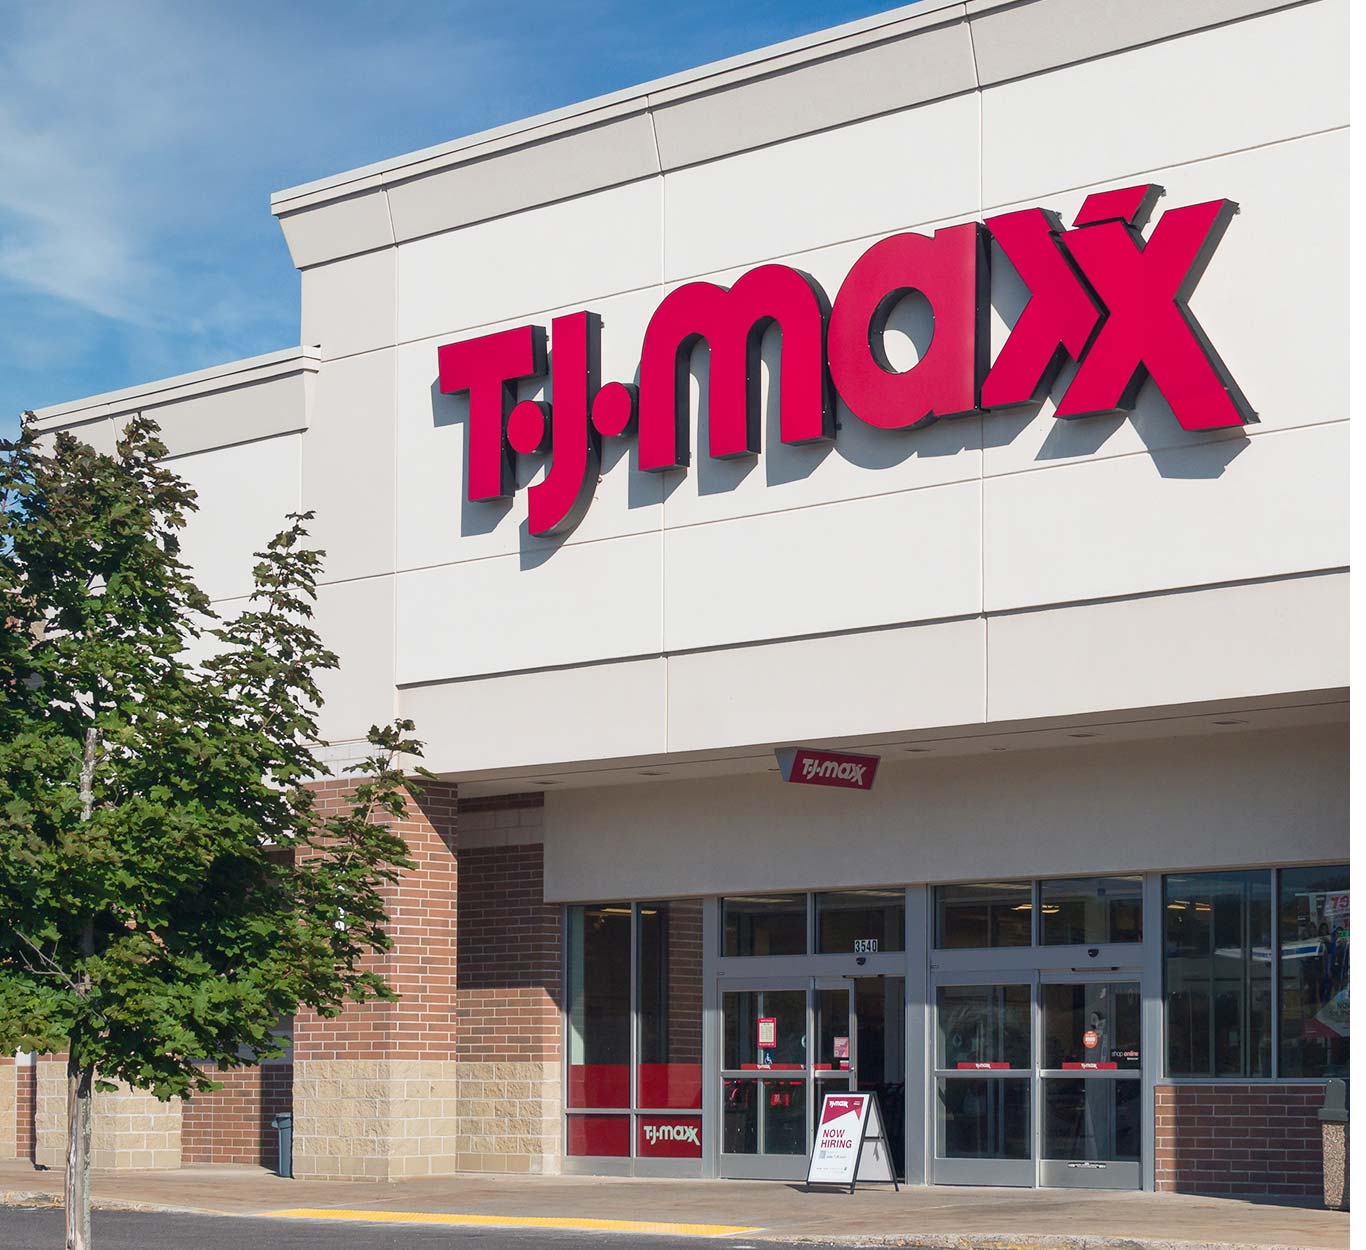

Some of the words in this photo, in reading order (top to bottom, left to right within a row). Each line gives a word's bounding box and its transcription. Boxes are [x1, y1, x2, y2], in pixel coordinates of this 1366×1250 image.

[855, 940, 877, 952] 3540
[822, 1129, 845, 1138] NOW
[820, 1139, 852, 1149] HIRING
